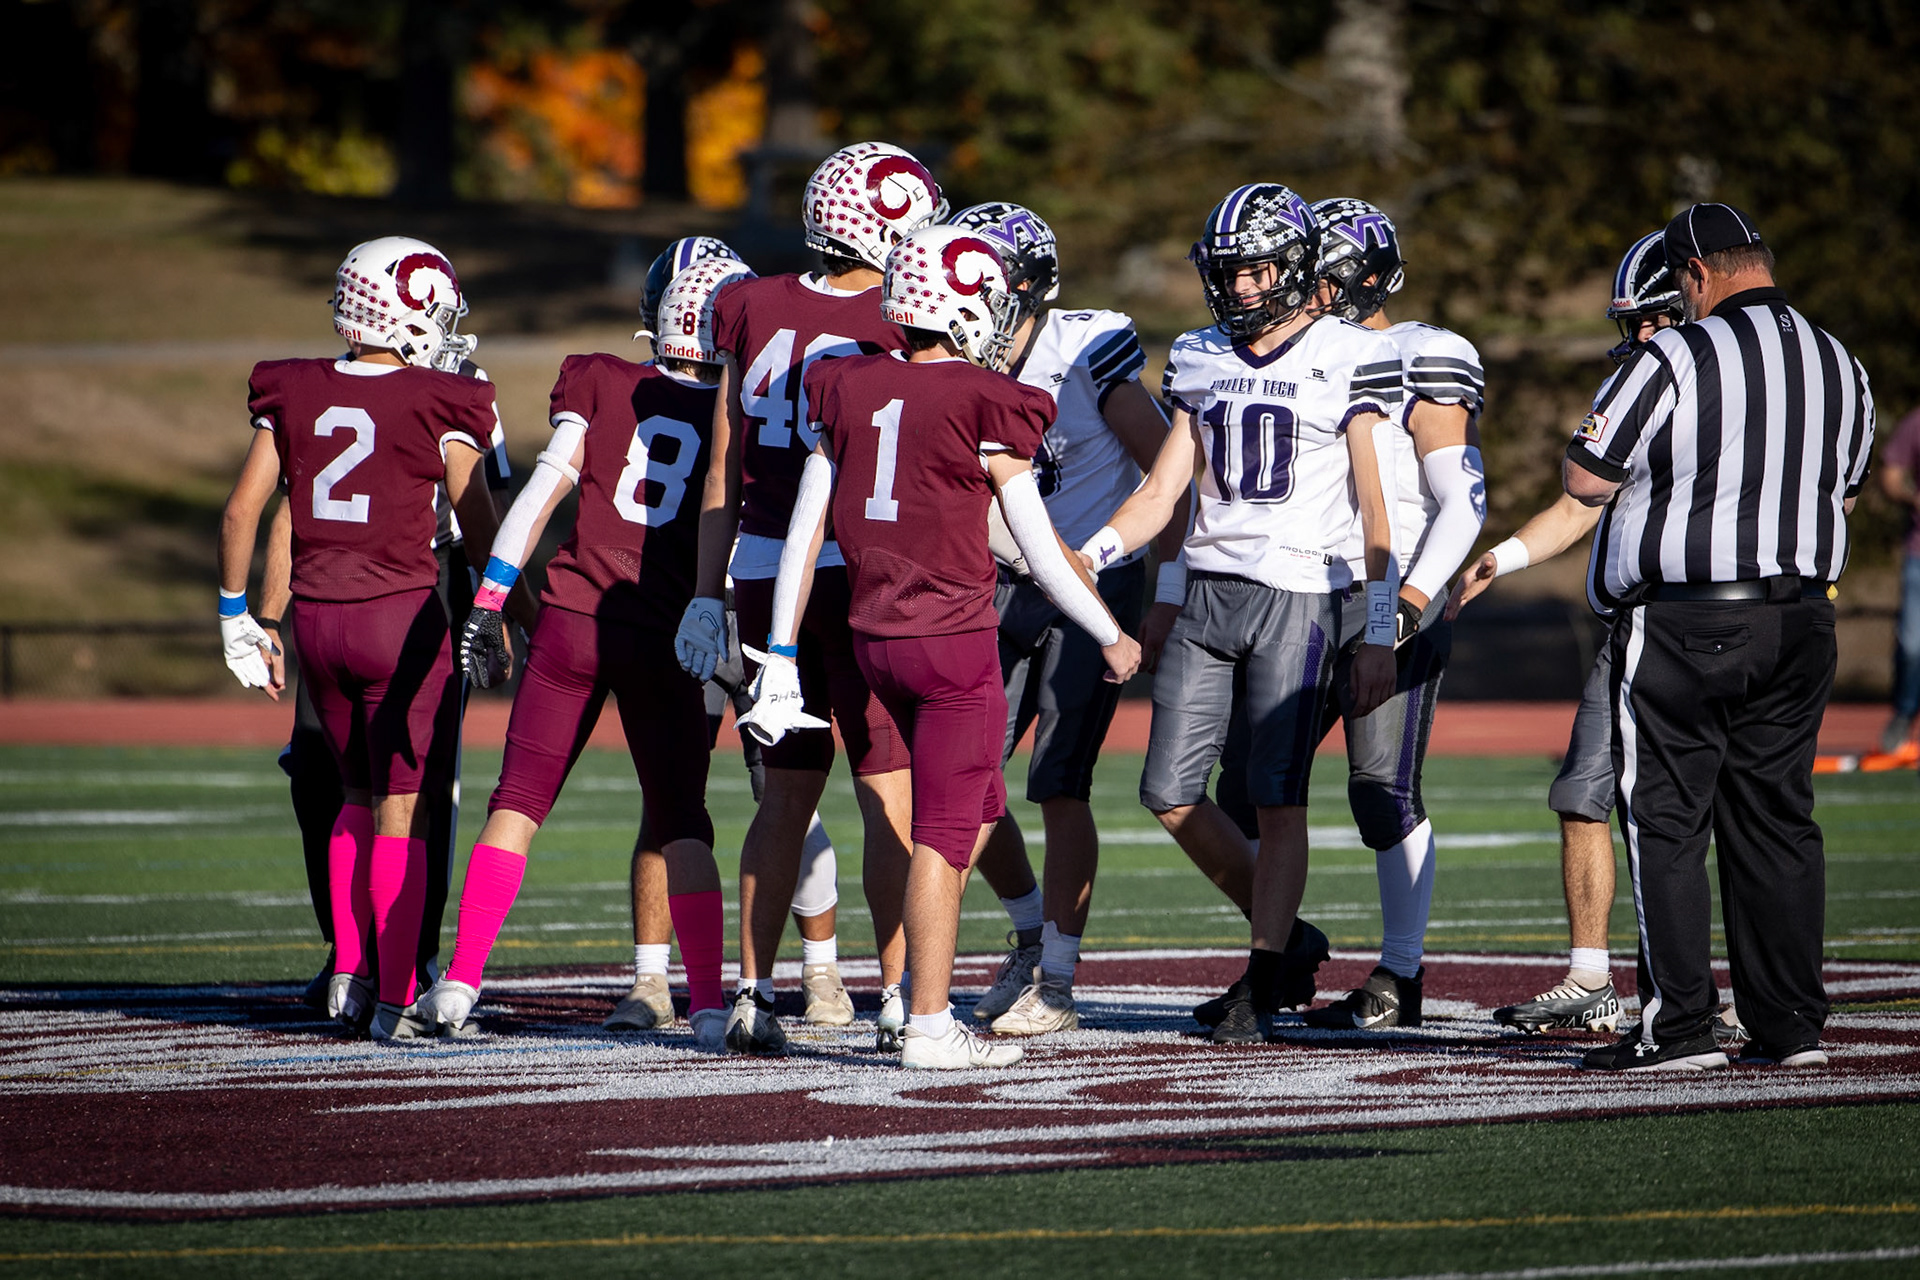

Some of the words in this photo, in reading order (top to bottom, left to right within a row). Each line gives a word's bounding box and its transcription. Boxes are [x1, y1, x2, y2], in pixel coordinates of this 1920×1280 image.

[980, 210, 1041, 255] VT
[1330, 213, 1388, 253] VT
[682, 311, 696, 336] 8
[1263, 379, 1299, 399] TECH
[312, 406, 376, 523] 2
[613, 414, 702, 528] 8
[865, 398, 905, 522] 1
[1203, 400, 1299, 505] 10
[1553, 998, 1617, 1028] VAPOR
